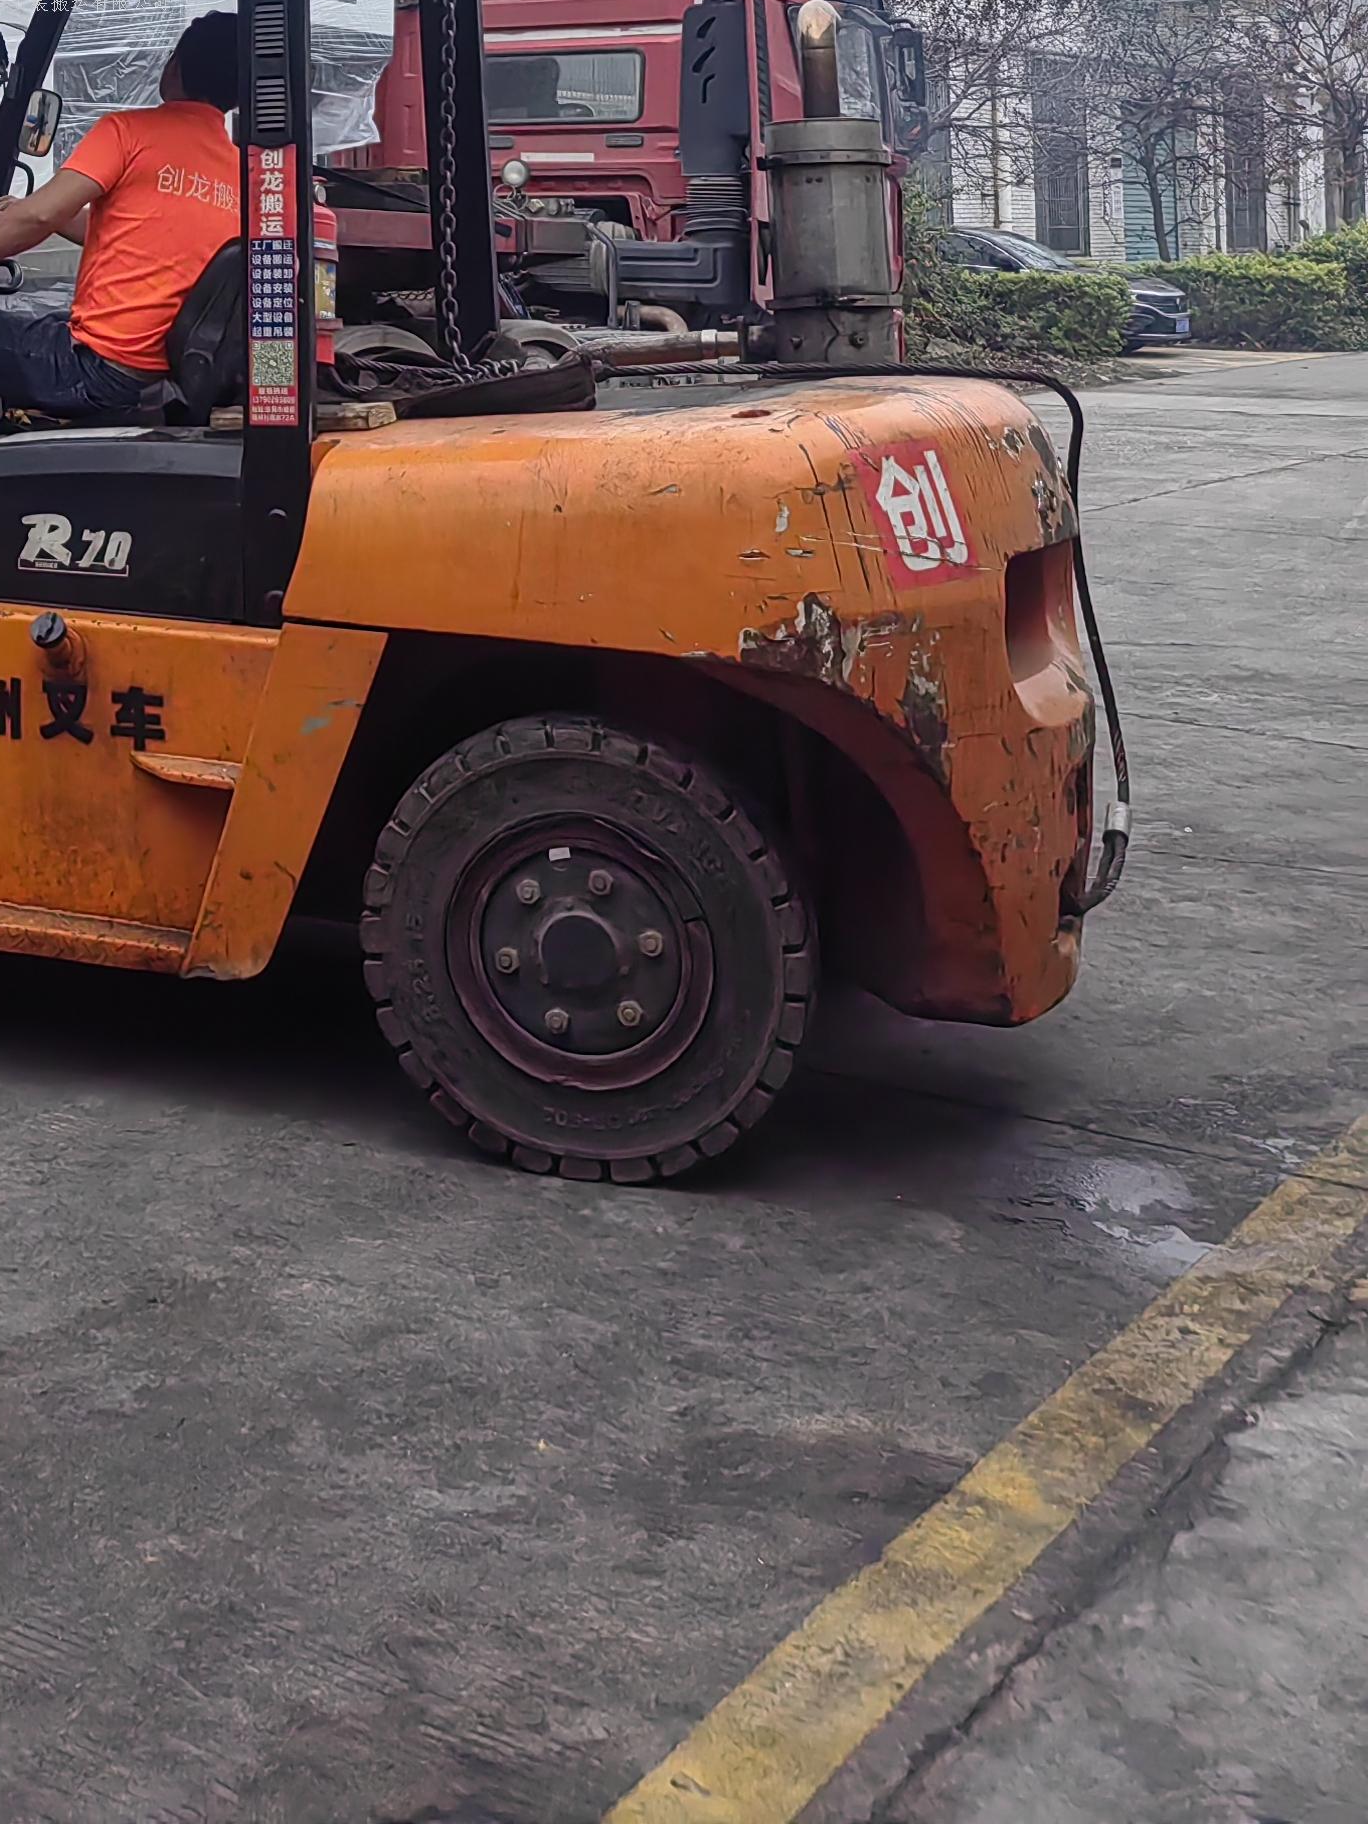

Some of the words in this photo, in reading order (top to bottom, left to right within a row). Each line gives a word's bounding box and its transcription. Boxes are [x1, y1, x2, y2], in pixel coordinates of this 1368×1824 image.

[260, 148, 284, 236] 创龙搬运
[251, 254, 293, 265] 设备搬运
[251, 283, 293, 294] 设备安装
[251, 297, 293, 308] 设备定位
[251, 311, 293, 323] 大型设备
[251, 326, 293, 337] 起重吊装
[875, 450, 969, 572] 创
